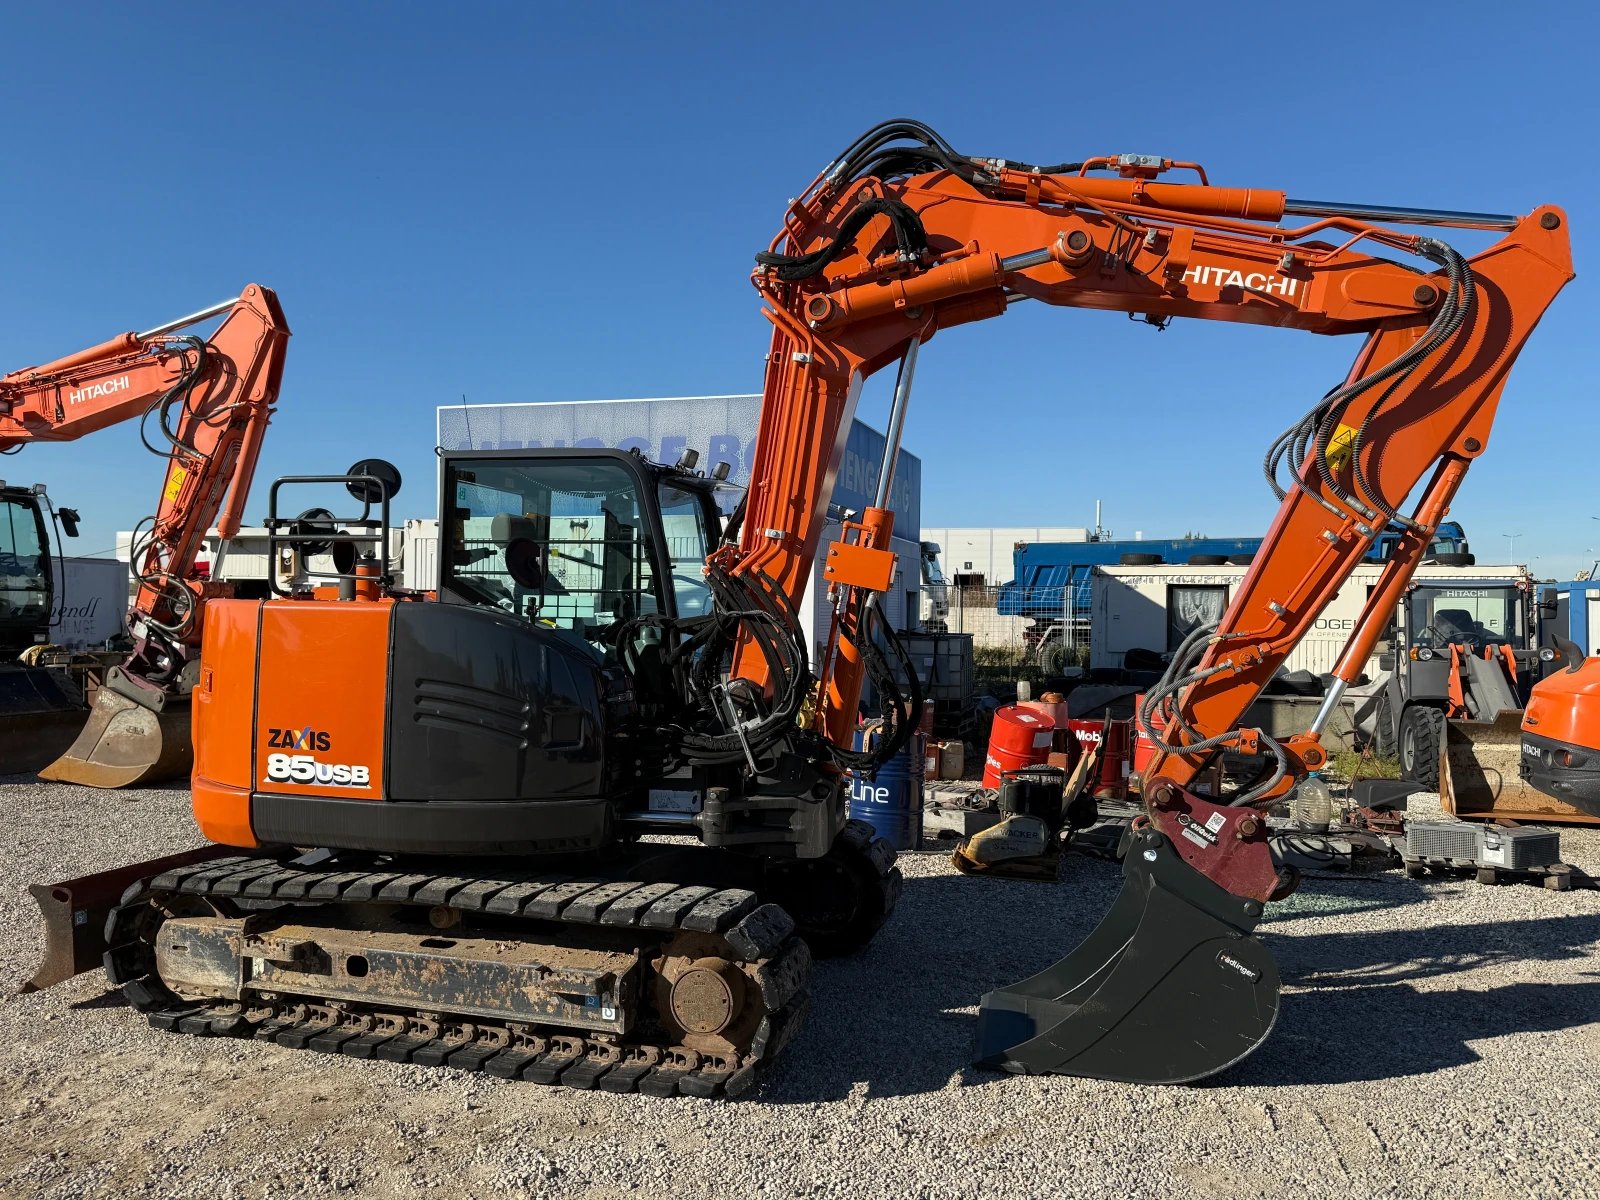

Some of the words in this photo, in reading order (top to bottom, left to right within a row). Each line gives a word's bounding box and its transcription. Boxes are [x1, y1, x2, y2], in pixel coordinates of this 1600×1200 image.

[1180, 265, 1297, 296] HITACHI
[70, 375, 130, 405] HITACHI
[267, 726, 331, 752] ZAXIS
[1522, 742, 1541, 758] HITACHI
[266, 753, 371, 787] 85USB
[1000, 829, 1039, 839] WACKER
[1190, 823, 1218, 843] OilQuick
